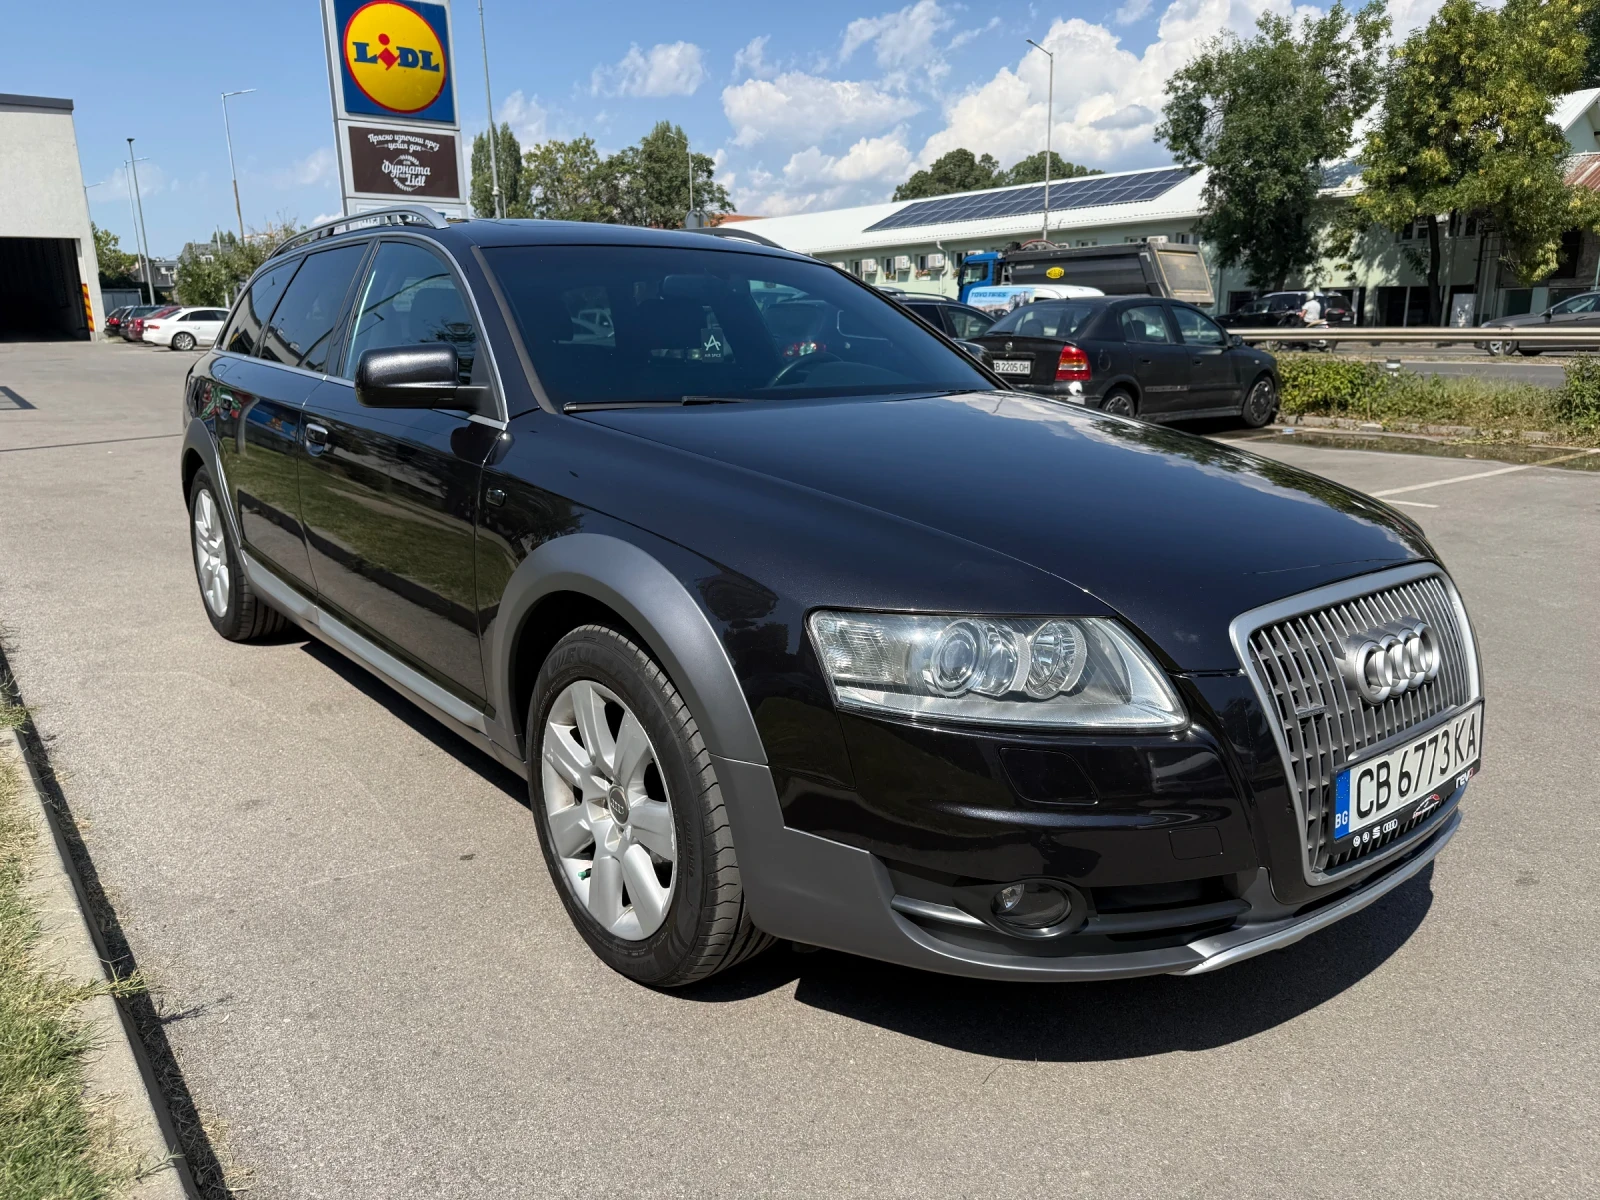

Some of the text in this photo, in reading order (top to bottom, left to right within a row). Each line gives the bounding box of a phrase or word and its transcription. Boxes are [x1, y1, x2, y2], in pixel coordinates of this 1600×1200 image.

[367, 133, 394, 145] Прясно
[381, 159, 431, 178] Фурната
[405, 173, 426, 187] Lidl
[1001, 362, 1018, 372] 2205
[1356, 711, 1476, 819] CB 6773 KA
[1335, 810, 1349, 829] BG
